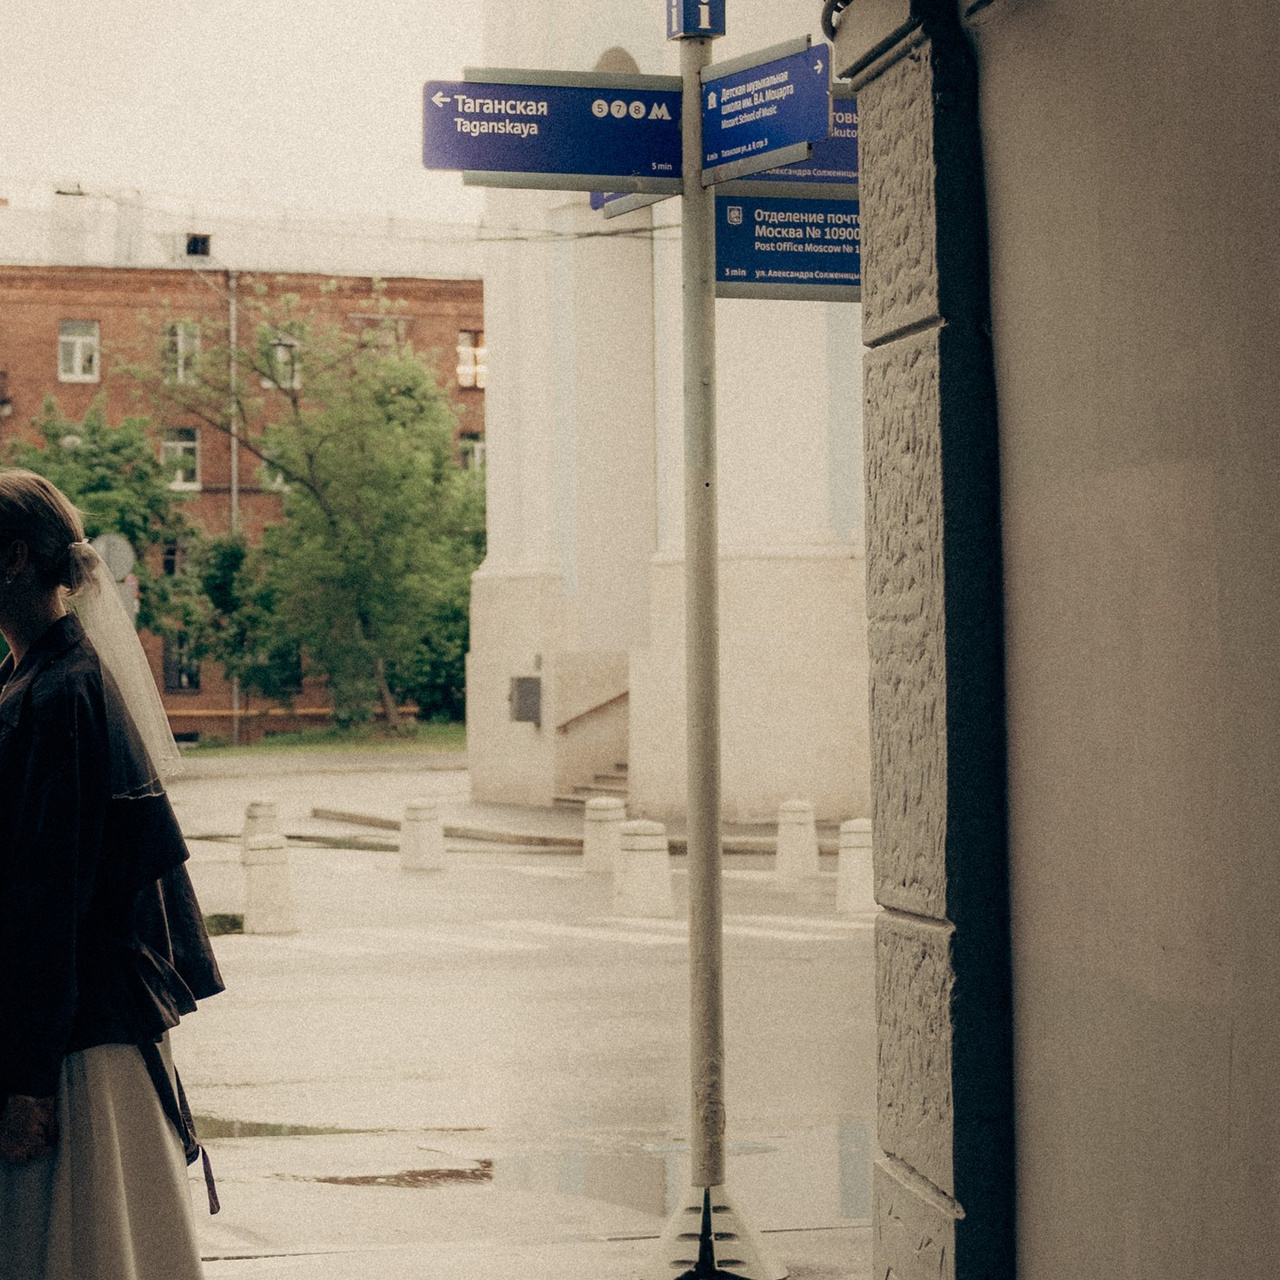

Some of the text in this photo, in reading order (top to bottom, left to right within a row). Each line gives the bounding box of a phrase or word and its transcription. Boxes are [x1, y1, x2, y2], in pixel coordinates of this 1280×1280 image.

[721, 71, 789, 103] Детская музыкальная
[454, 95, 548, 116] Таганская
[721, 101, 741, 115] школа
[765, 84, 794, 101] Моцарта
[739, 110, 756, 124] School
[762, 105, 777, 117] Music
[454, 118, 538, 138] Taganskaya
[754, 209, 824, 224] Отделение
[754, 225, 803, 238] Москва
[806, 226, 821, 238] №
[754, 241, 775, 251] Post
[776, 242, 803, 252] Office
[805, 243, 841, 253] Moscow
[730, 268, 746, 276] min
[755, 270, 766, 278] ул.
[767, 269, 813, 279] Александра
